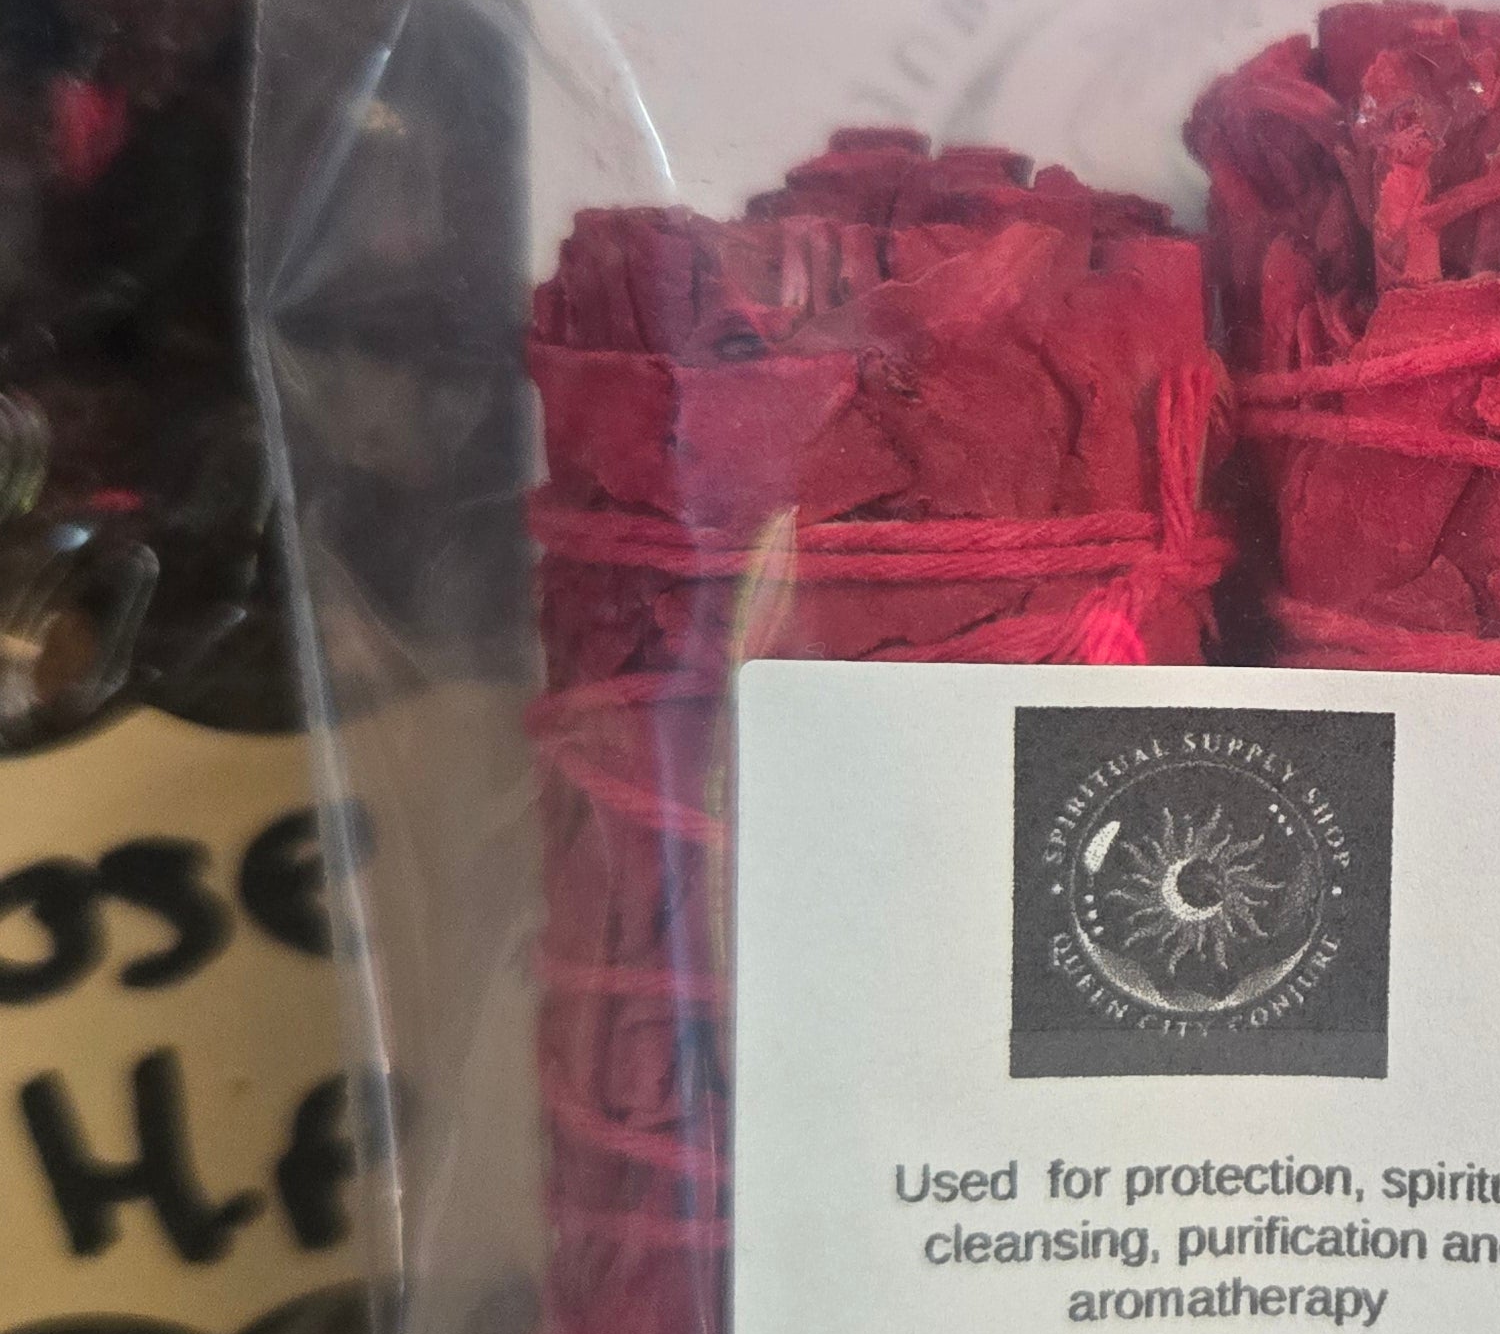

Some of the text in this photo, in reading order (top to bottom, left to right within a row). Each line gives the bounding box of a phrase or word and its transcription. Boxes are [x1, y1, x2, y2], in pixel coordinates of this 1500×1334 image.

[1042, 732, 1351, 869] SPIRITUAL SUPPLY SHOP
[1050, 931, 1130, 1022] QUEEN
[895, 1160, 1018, 1204] Used
[1046, 1158, 1111, 1201] for
[1125, 1154, 1365, 1207] protection,
[923, 1219, 1160, 1269] cleansing,
[1177, 1215, 1428, 1267] purification
[1066, 1276, 1389, 1329] aromatherapy
